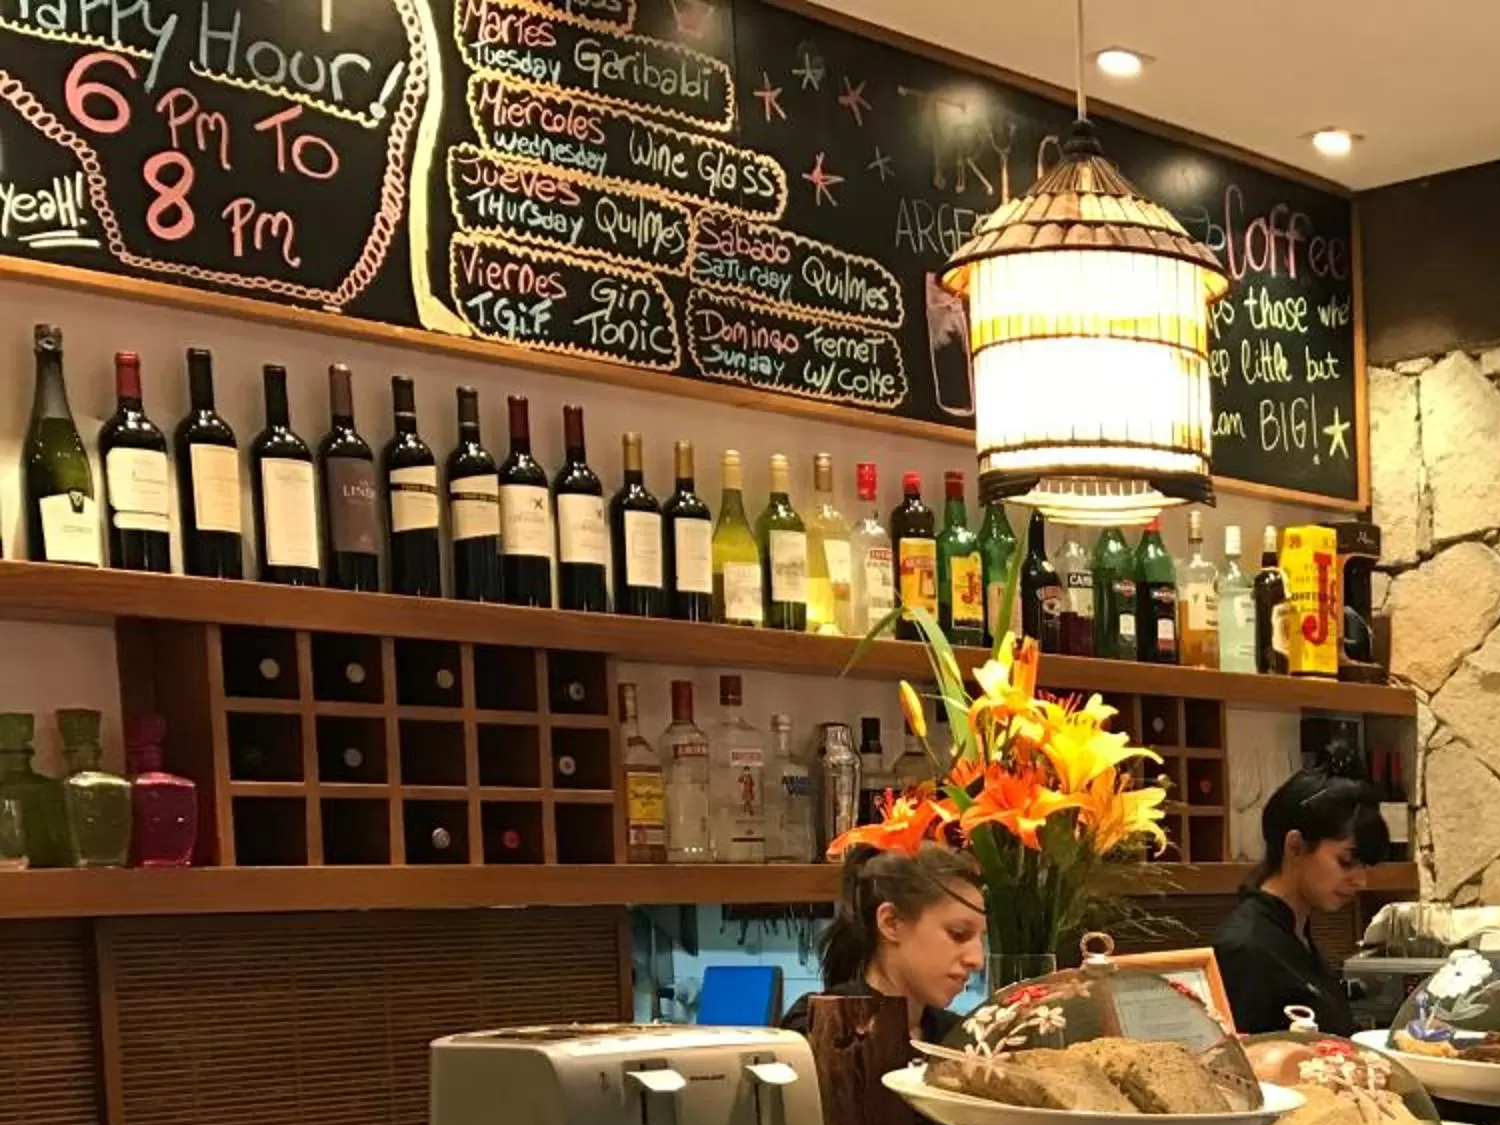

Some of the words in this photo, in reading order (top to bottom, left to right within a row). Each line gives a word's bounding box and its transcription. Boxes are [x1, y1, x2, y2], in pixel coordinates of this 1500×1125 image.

[65, 52, 137, 133] 6
[469, 40, 561, 83] Tuesday
[574, 38, 711, 101] Garibaldi
[458, 156, 581, 206] Jueves
[629, 128, 688, 178] Wine
[697, 150, 775, 197] Glass
[143, 151, 195, 239] 8
[895, 197, 990, 259] ARGE
[460, 245, 567, 299] Viernes
[591, 277, 650, 322] Gin
[1243, 285, 1308, 333] those
[573, 308, 673, 354] Tonic
[695, 309, 799, 354] Domingo
[702, 344, 785, 383] Sunday
[1241, 338, 1293, 384] little
[1305, 345, 1340, 383] but
[1260, 391, 1320, 465] BIG!
